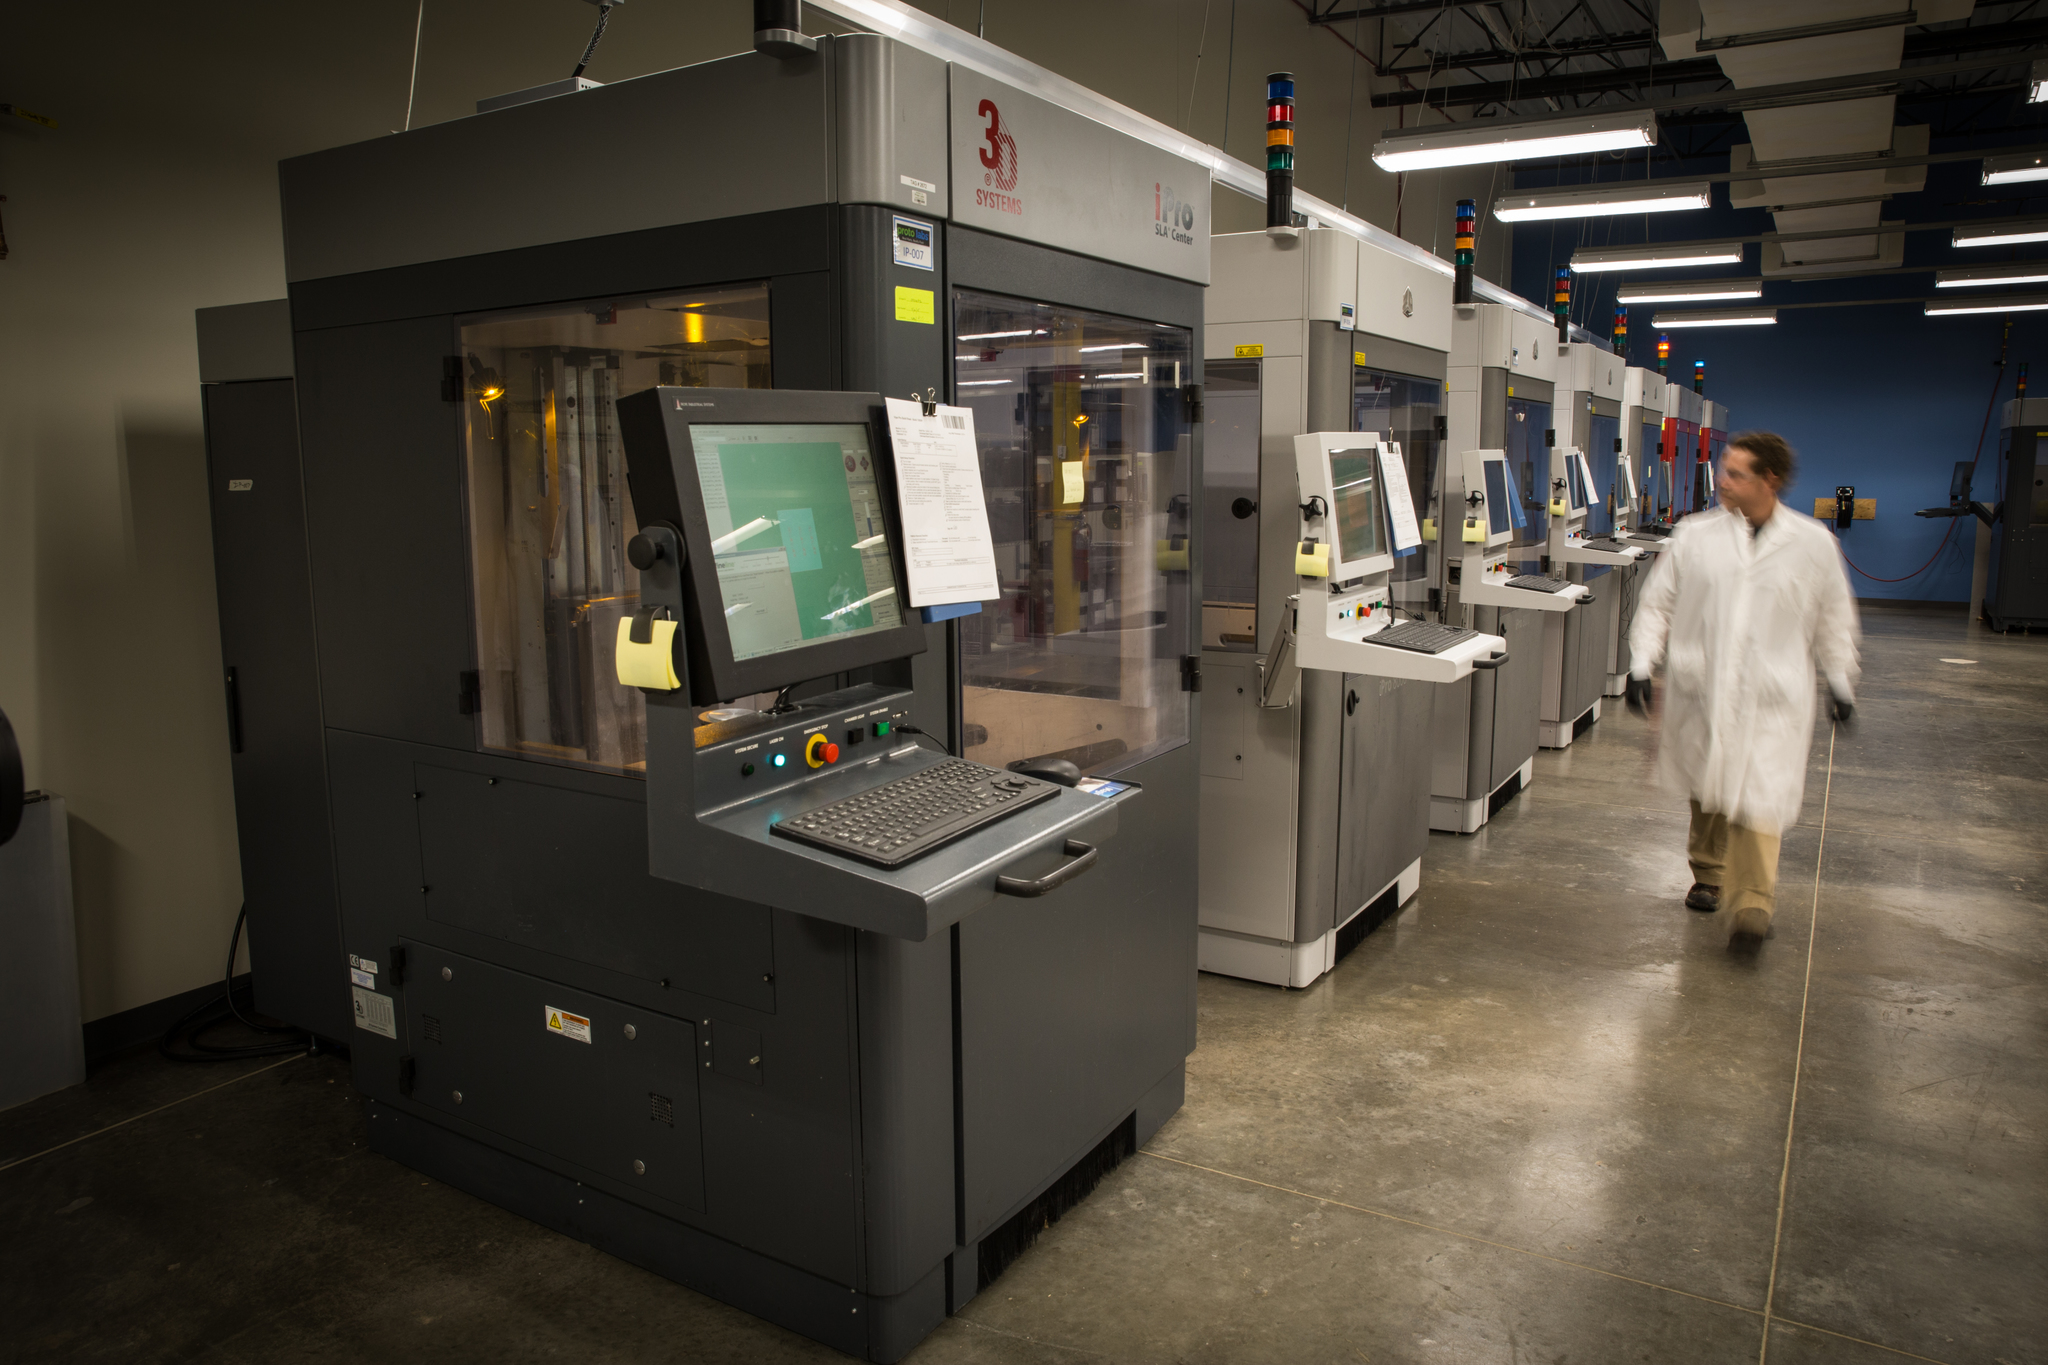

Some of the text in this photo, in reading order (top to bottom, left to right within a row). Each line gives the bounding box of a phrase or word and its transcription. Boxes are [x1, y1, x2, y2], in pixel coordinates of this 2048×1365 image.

[975, 187, 1023, 216] SYSTEMS
[1155, 181, 1194, 231] iPro
[897, 226, 929, 241] proto labs
[1171, 228, 1194, 246] Center
[903, 246, 924, 260] IP-007
